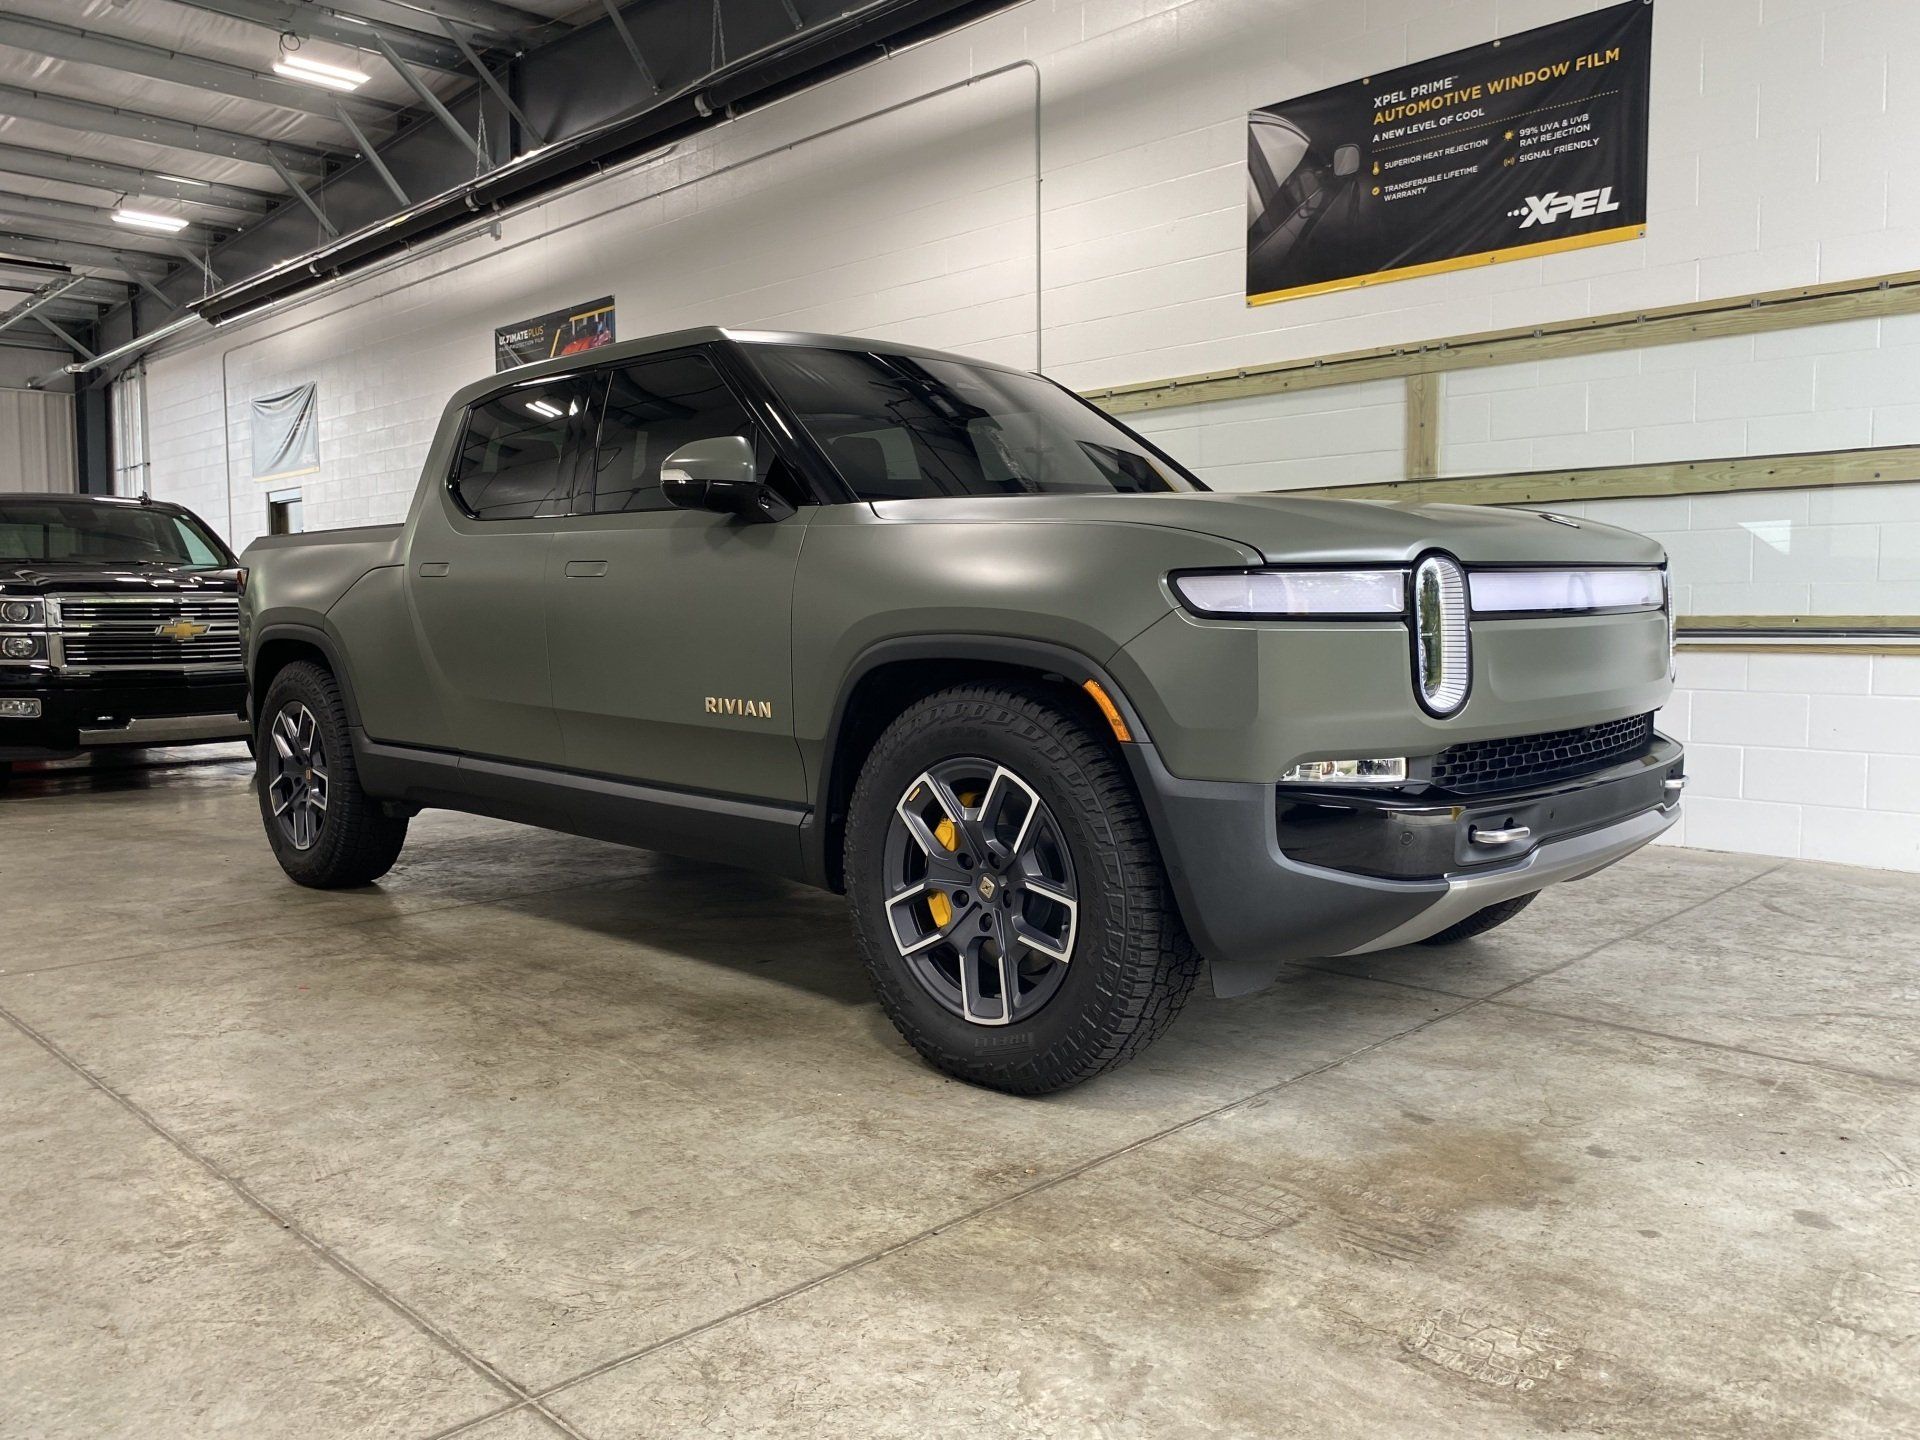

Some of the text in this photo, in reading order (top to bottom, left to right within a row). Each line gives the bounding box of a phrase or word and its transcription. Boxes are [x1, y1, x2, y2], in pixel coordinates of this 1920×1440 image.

[1373, 48, 1620, 125] AUTOMOTIVE WINDOW FILM
[1373, 91, 1407, 108] XPEL
[1372, 108, 1485, 143] A NEW LEVEL OF COOL
[1519, 113, 1589, 137] 99% UVA & UVB
[1520, 124, 1591, 148] RAY REJECTION
[1384, 139, 1489, 169] SUPERIOR HEAT REJECTION
[1519, 138, 1600, 163] SIGNAL FRIENDLY
[1384, 165, 1478, 192] TRANSFERABLE LIFETIME
[1384, 186, 1428, 202] WARRANTY
[1518, 186, 1620, 229] XPEL
[704, 696, 772, 719] RIVIAN
